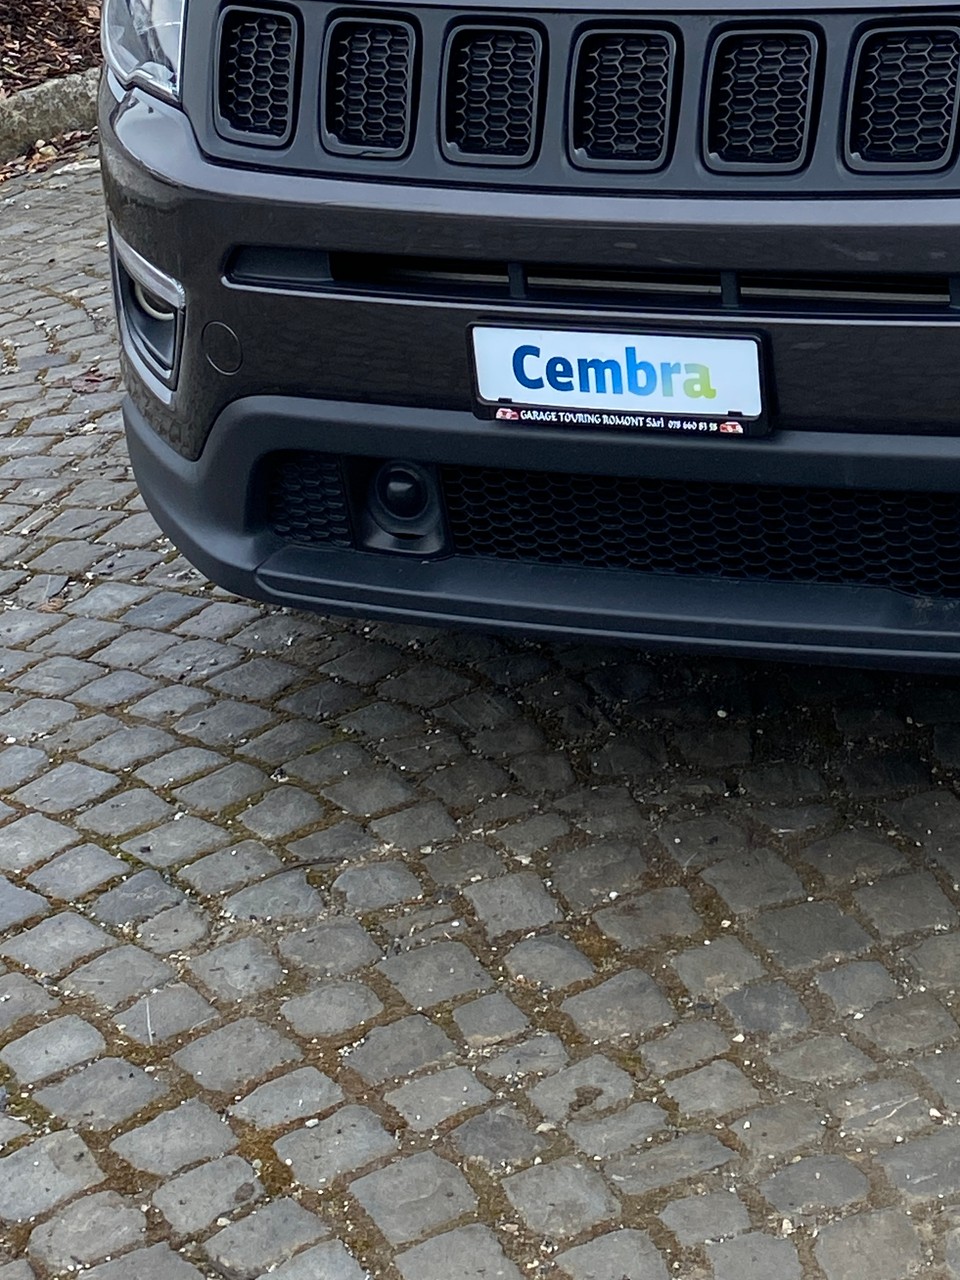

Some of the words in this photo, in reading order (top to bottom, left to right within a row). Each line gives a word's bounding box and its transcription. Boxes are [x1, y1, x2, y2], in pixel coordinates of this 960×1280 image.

[512, 344, 717, 399] Cembra
[520, 409, 557, 421] GARAGE
[558, 412, 601, 424] TOURING
[602, 415, 644, 426] ROMONT
